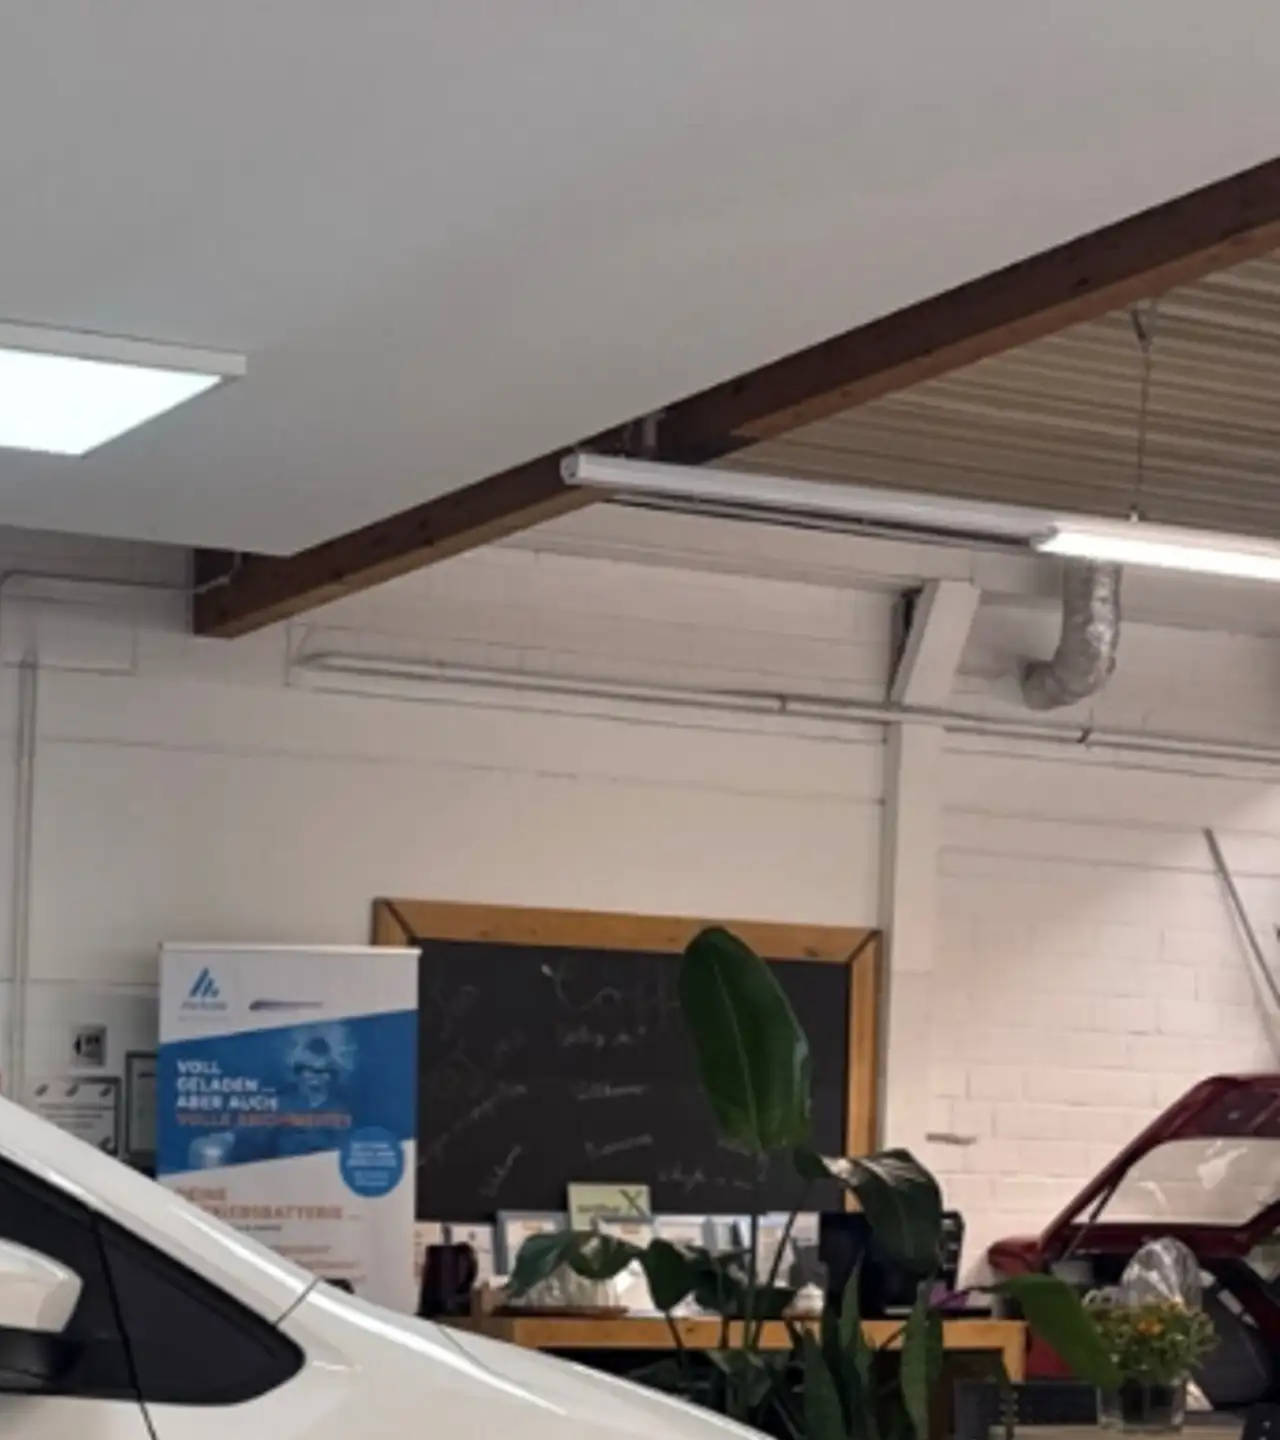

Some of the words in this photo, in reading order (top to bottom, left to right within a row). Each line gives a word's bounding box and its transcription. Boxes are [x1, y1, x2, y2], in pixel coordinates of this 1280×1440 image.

[176, 1059, 223, 1075] VOLL
[176, 1077, 259, 1093] GELADEN
[176, 1094, 223, 1110] ABER
[228, 1095, 278, 1112] AUCH
